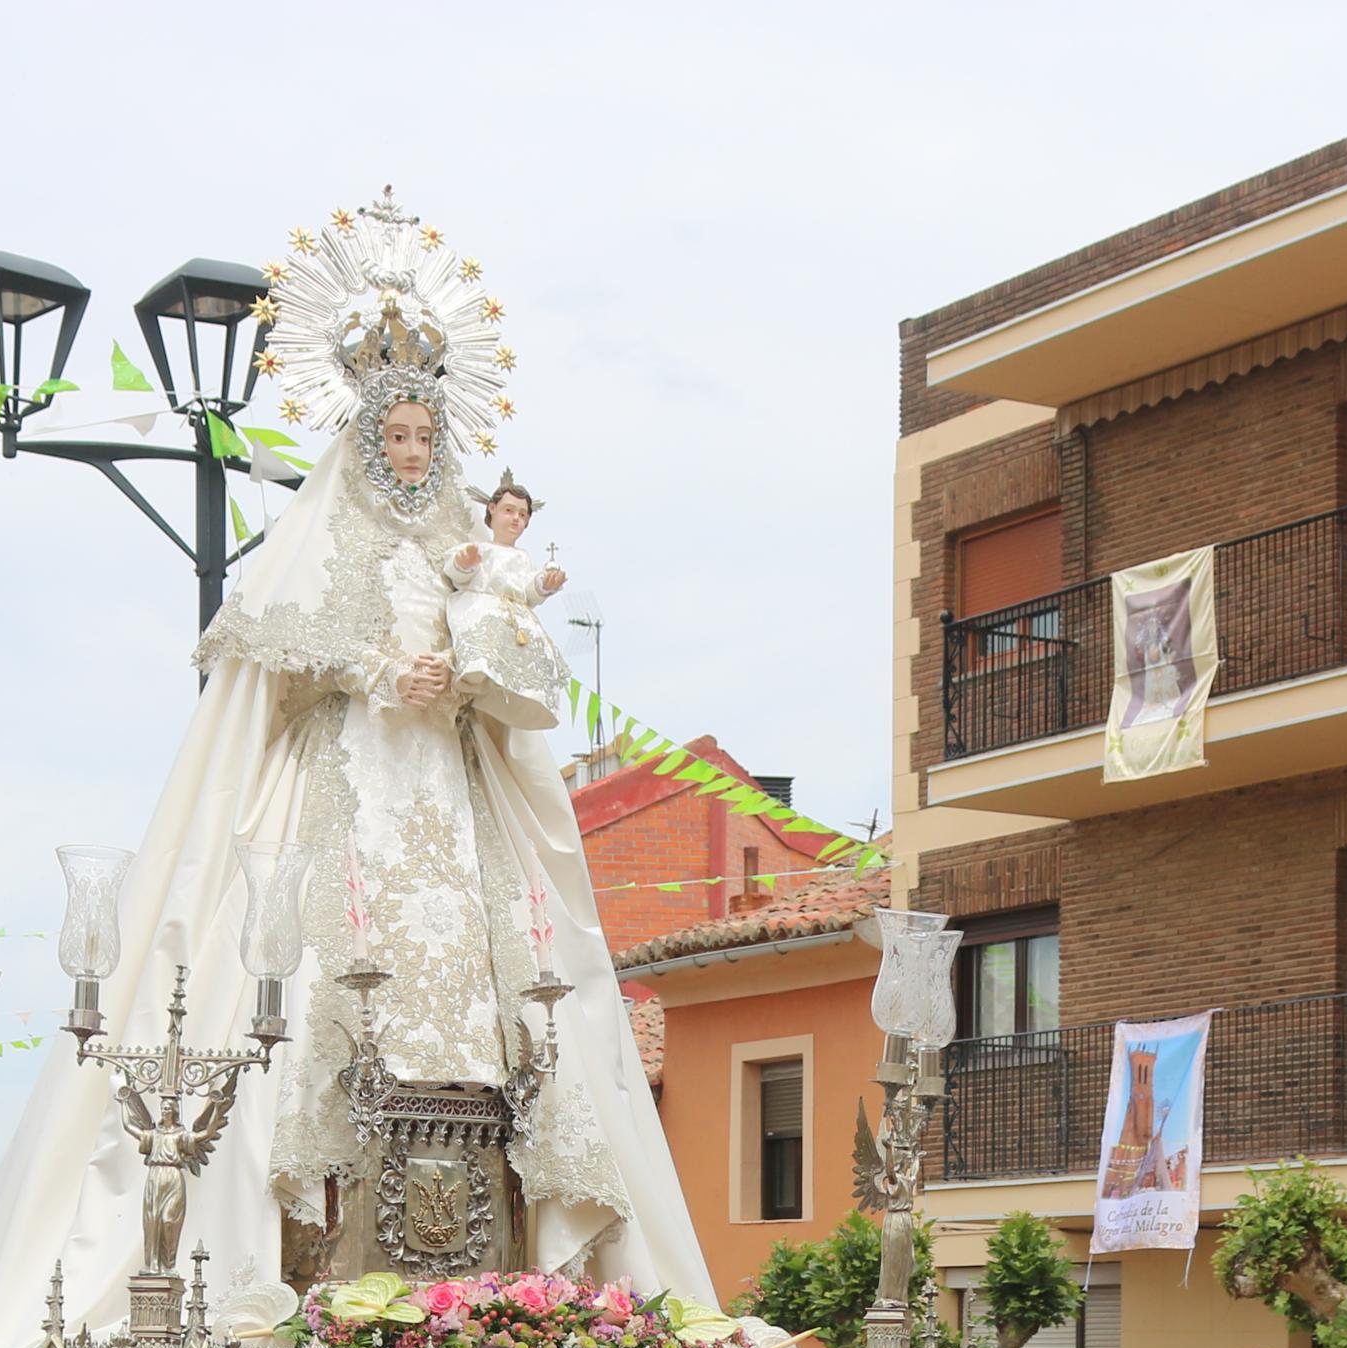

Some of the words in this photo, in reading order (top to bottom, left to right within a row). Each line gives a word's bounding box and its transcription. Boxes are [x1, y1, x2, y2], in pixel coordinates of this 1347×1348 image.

[1141, 1200, 1154, 1216] de
[1156, 1199, 1169, 1215] la
[1135, 1215, 1183, 1236] Milagro
